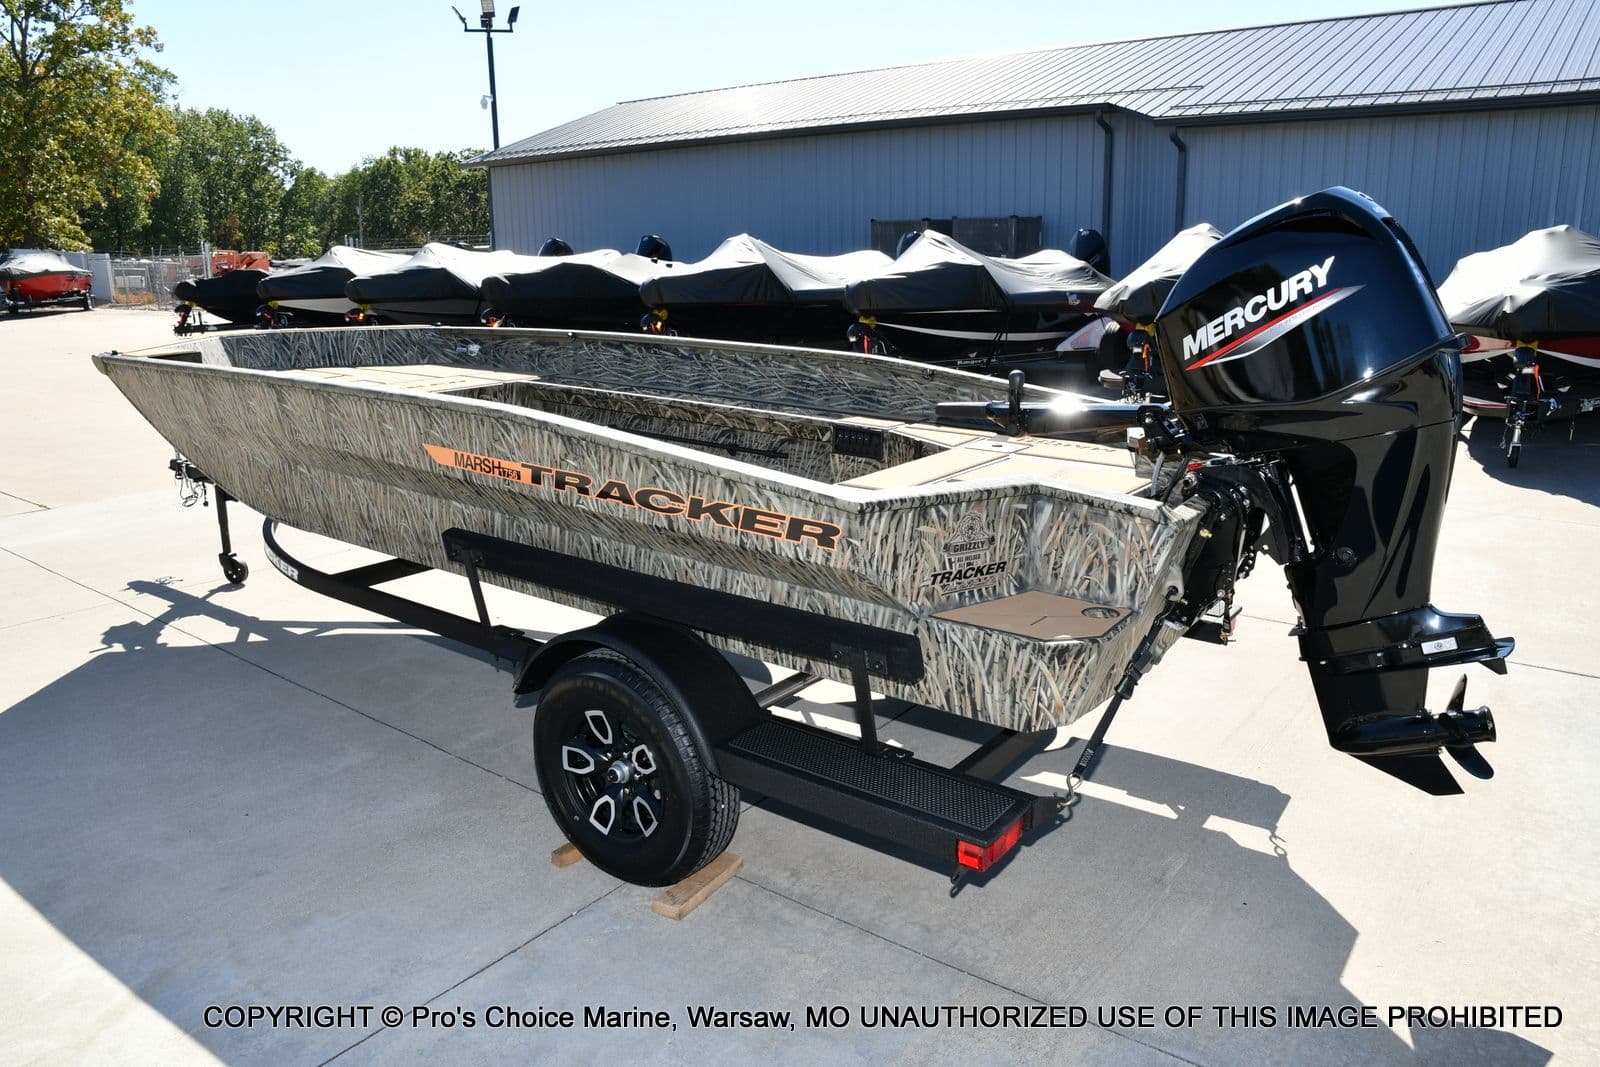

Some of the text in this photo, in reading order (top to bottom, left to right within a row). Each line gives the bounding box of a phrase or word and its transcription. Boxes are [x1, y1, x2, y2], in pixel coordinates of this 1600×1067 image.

[1182, 255, 1335, 361] MERCURY
[454, 451, 501, 475] MARSH
[521, 461, 841, 549] TRACKER
[931, 561, 1007, 585] TRACKER
[953, 541, 985, 552] GRIZZLY
